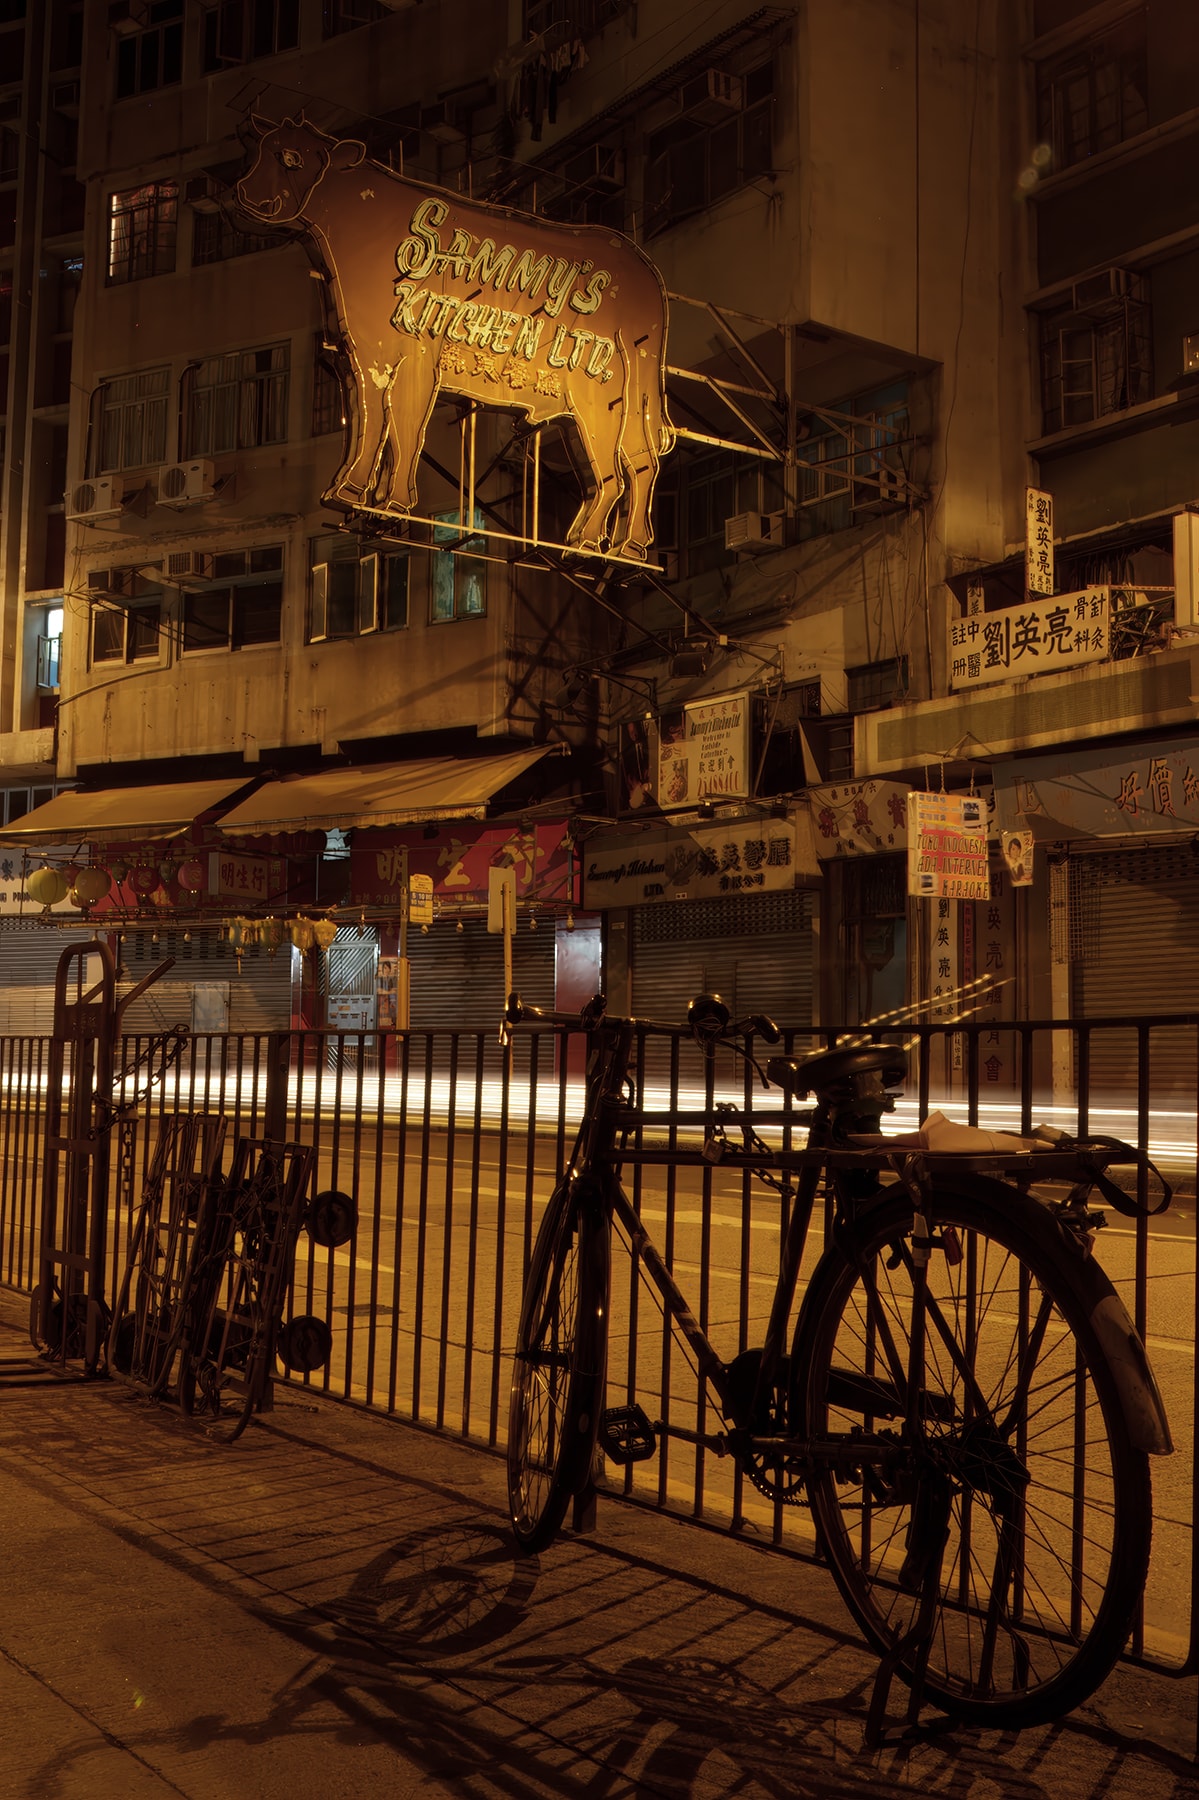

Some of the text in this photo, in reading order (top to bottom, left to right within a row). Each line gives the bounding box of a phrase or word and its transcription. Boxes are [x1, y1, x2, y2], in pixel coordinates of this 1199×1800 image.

[391, 282, 546, 361] KITCHEN
[1035, 498, 1051, 577] 劉英亮
[982, 606, 1073, 668] 劉英亮
[221, 862, 266, 894] 明生行
[942, 879, 989, 899] KARAOKE
